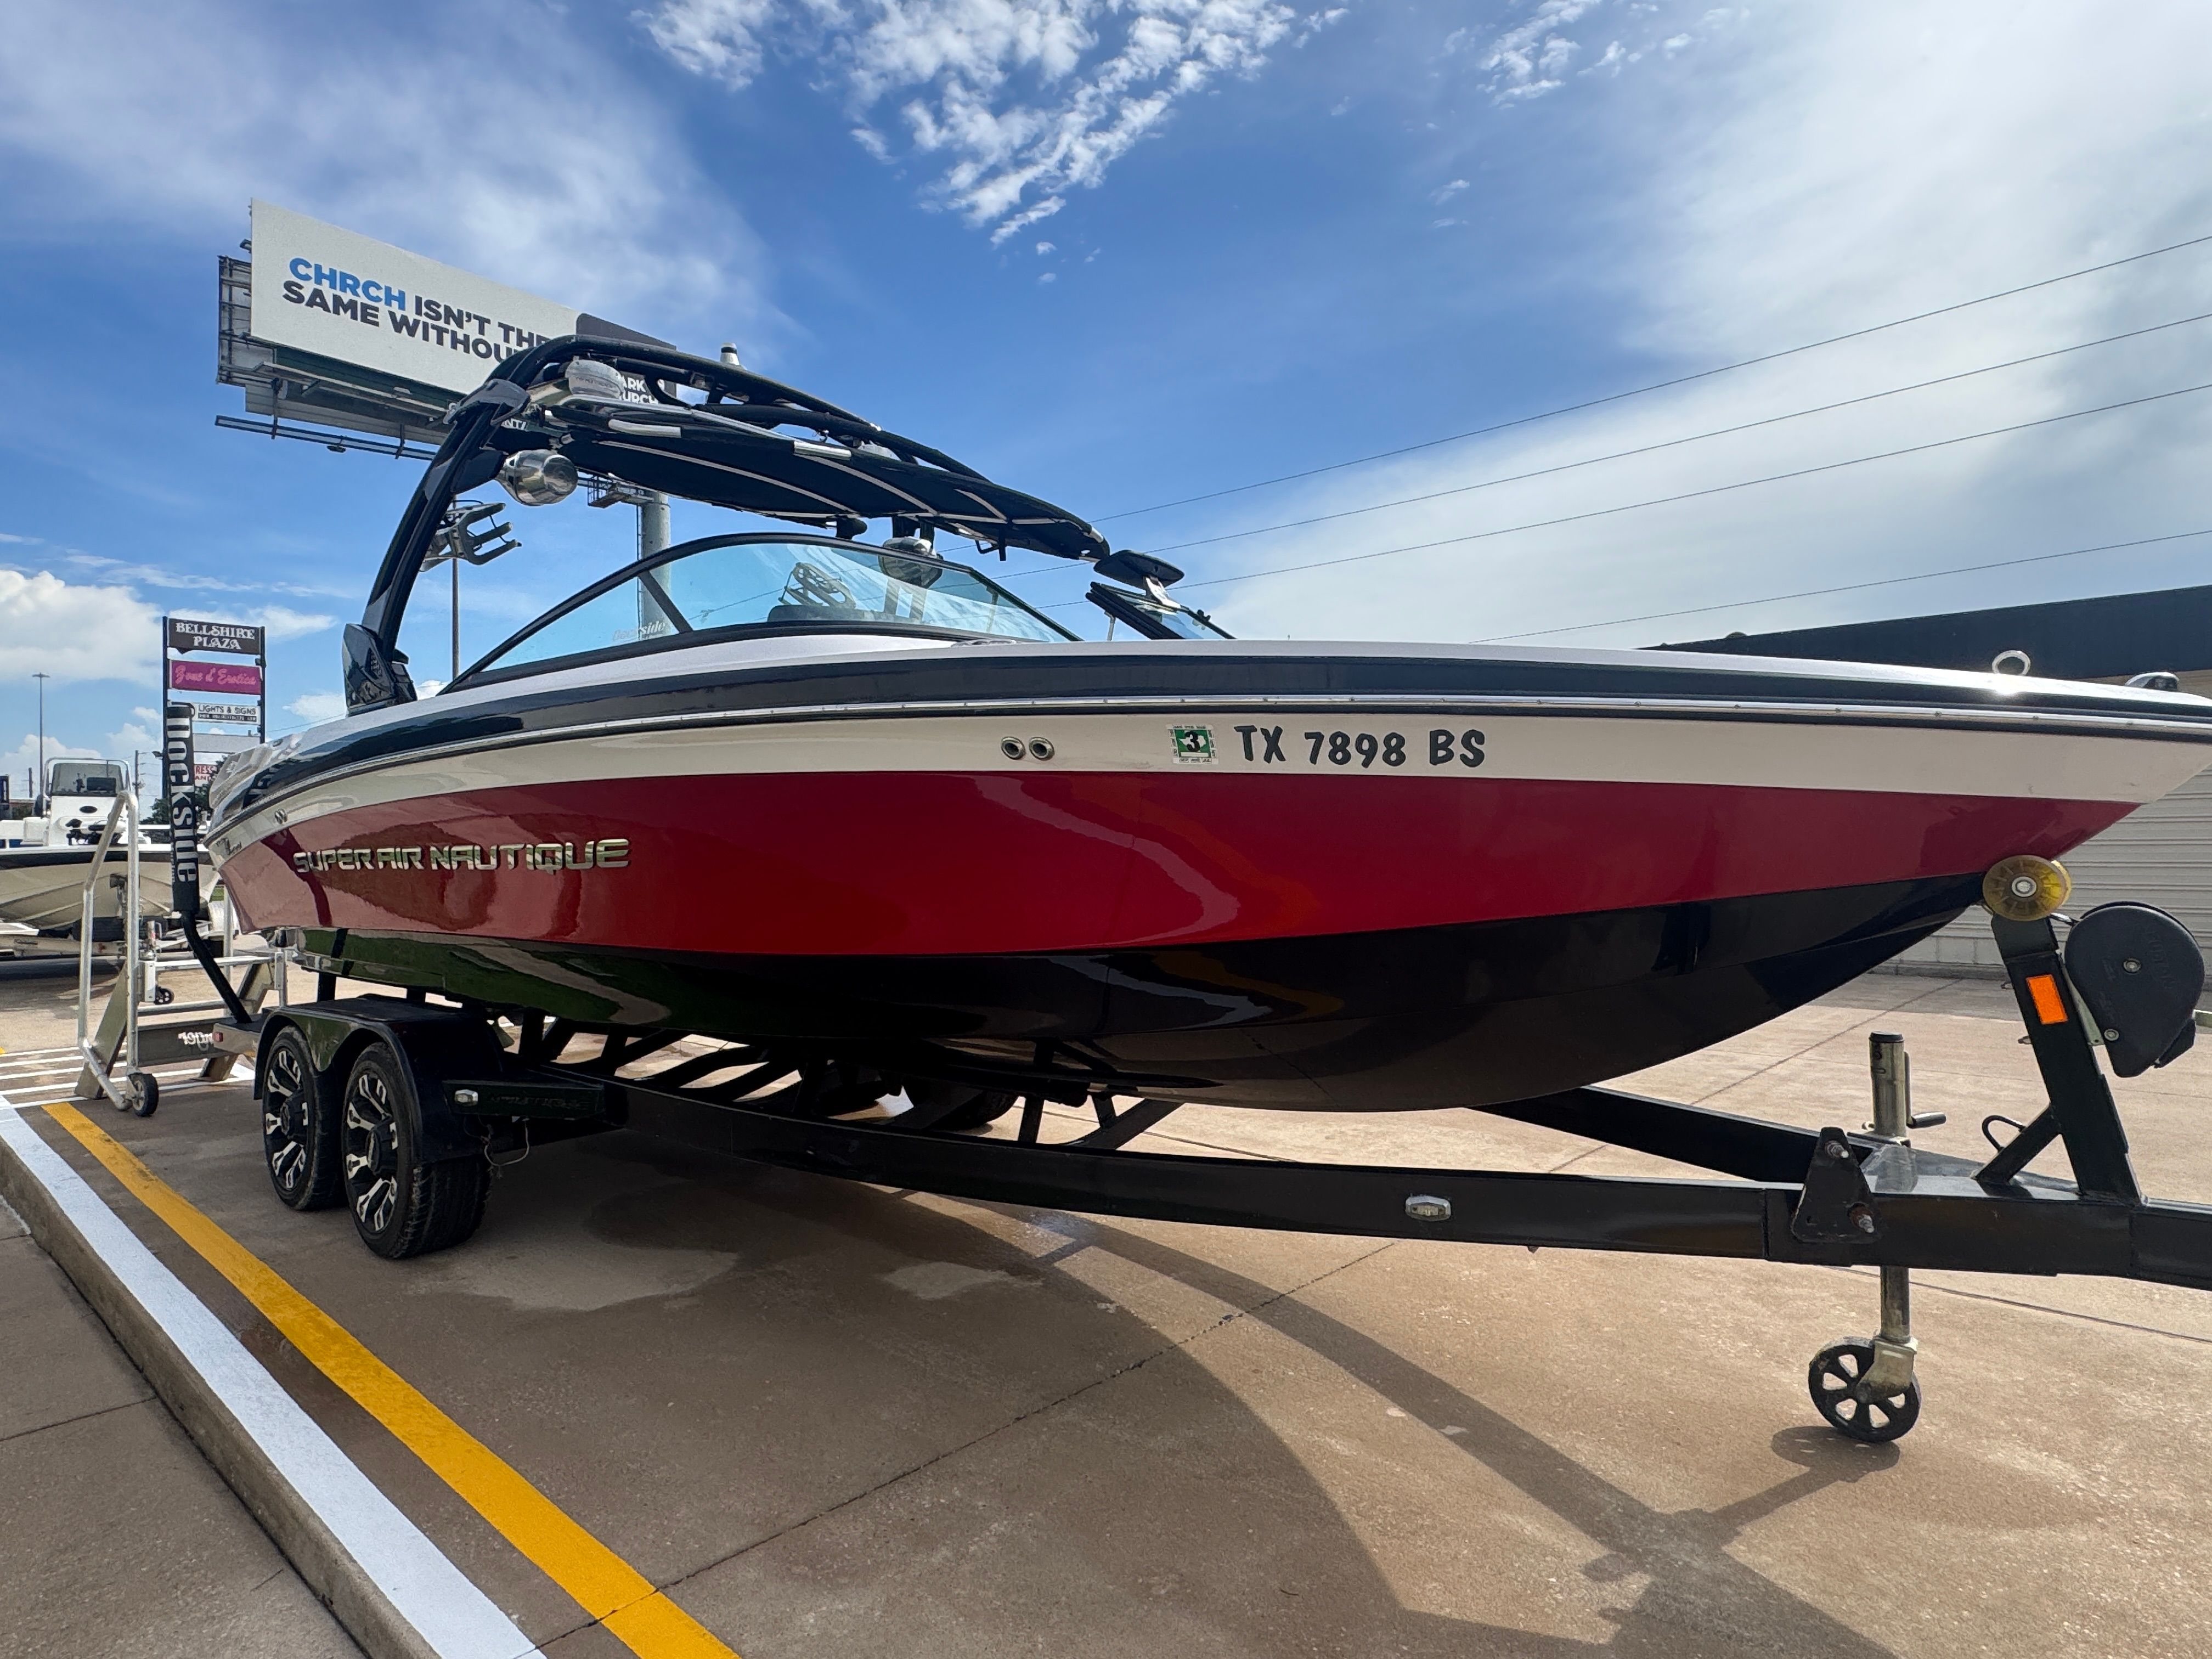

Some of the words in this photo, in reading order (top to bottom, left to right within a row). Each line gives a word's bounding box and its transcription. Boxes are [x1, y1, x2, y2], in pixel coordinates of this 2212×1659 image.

[289, 257, 405, 311] CHRCH
[415, 295, 491, 336] ISN'T
[283, 280, 380, 328] SAME
[387, 310, 521, 363] WITHOU
[176, 622, 256, 640] BELLSHIRE
[193, 636, 241, 650] PLAZA
[199, 704, 224, 713] LIGHTS
[1184, 731, 1200, 752] 3
[1234, 725, 1286, 764] TX
[1305, 731, 1406, 768] 7898
[1430, 729, 1485, 768] BS
[293, 848, 374, 873] SUPER
[377, 847, 425, 870] AIR
[430, 838, 629, 875] NAUTIQUE
